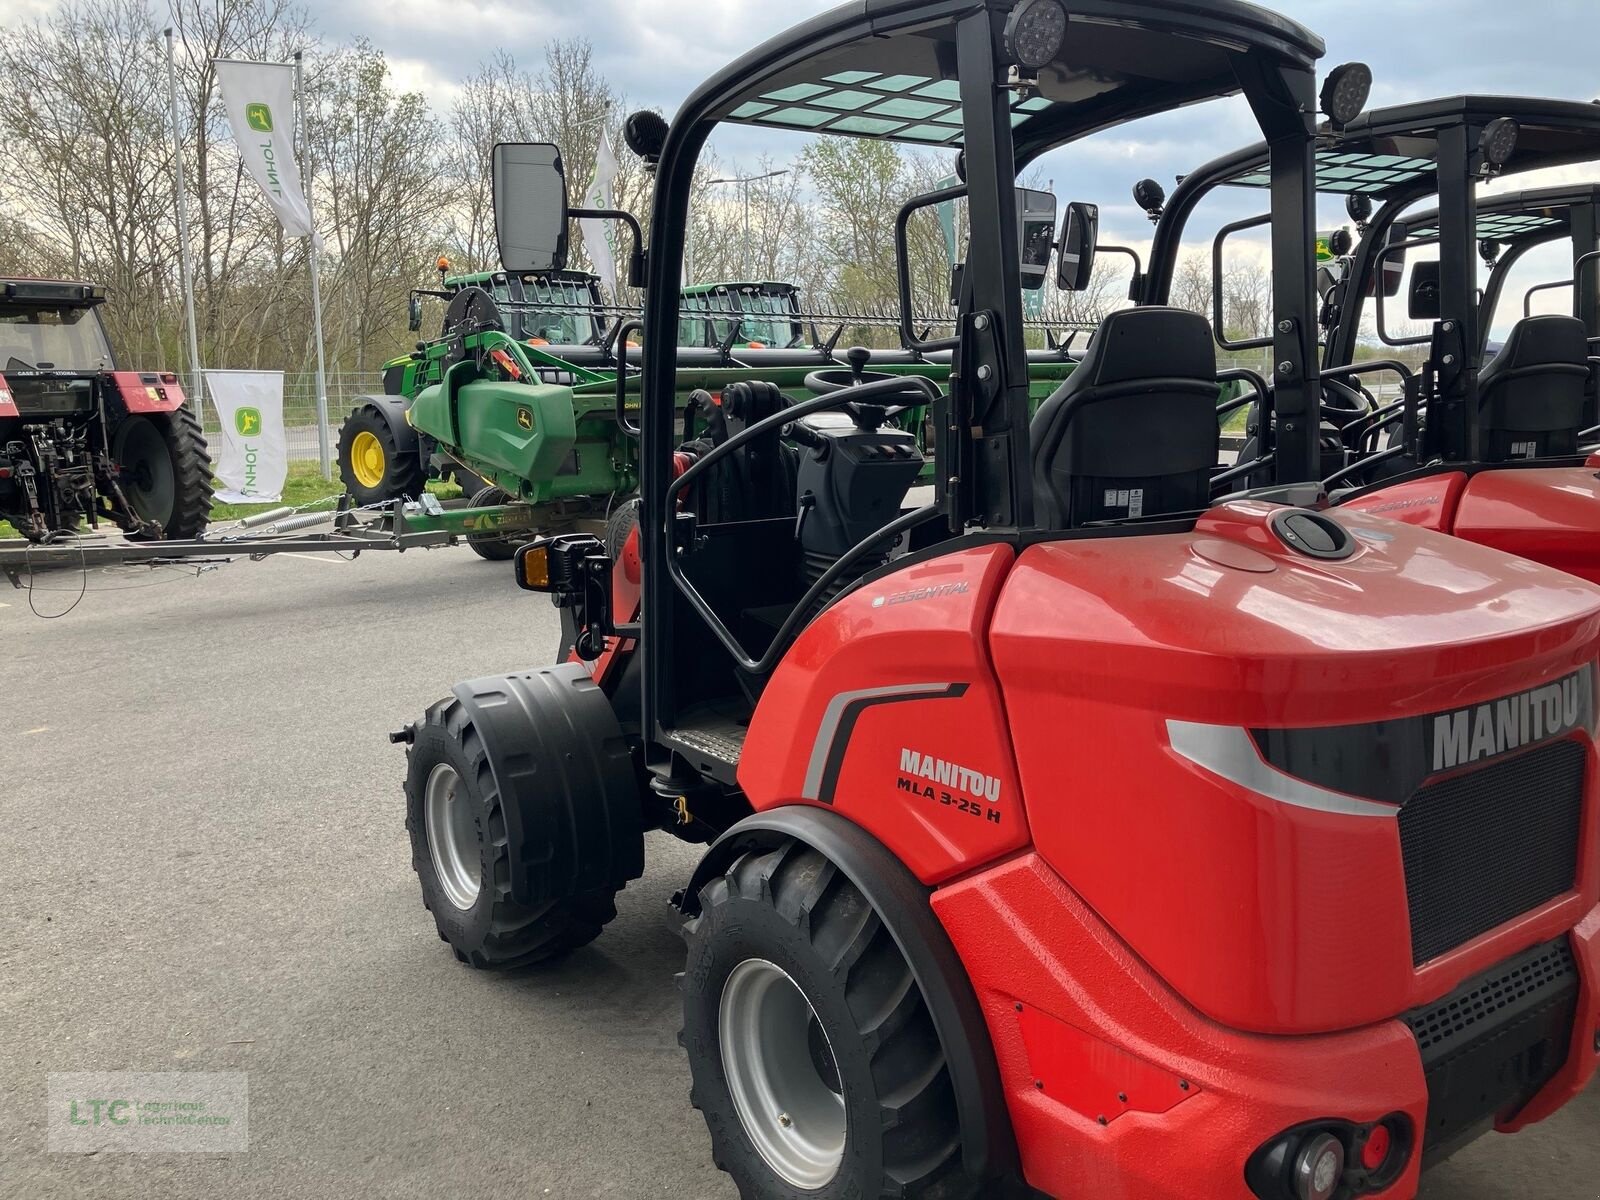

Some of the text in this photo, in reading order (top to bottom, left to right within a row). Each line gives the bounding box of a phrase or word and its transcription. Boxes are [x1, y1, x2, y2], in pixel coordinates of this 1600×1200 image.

[245, 443, 259, 487] JOHN
[888, 581, 969, 606] ESSENTIAL
[1432, 675, 1578, 771] MANITOU
[900, 747, 1001, 802] MANITOU
[897, 777, 1001, 824] MLA 3-25 H
